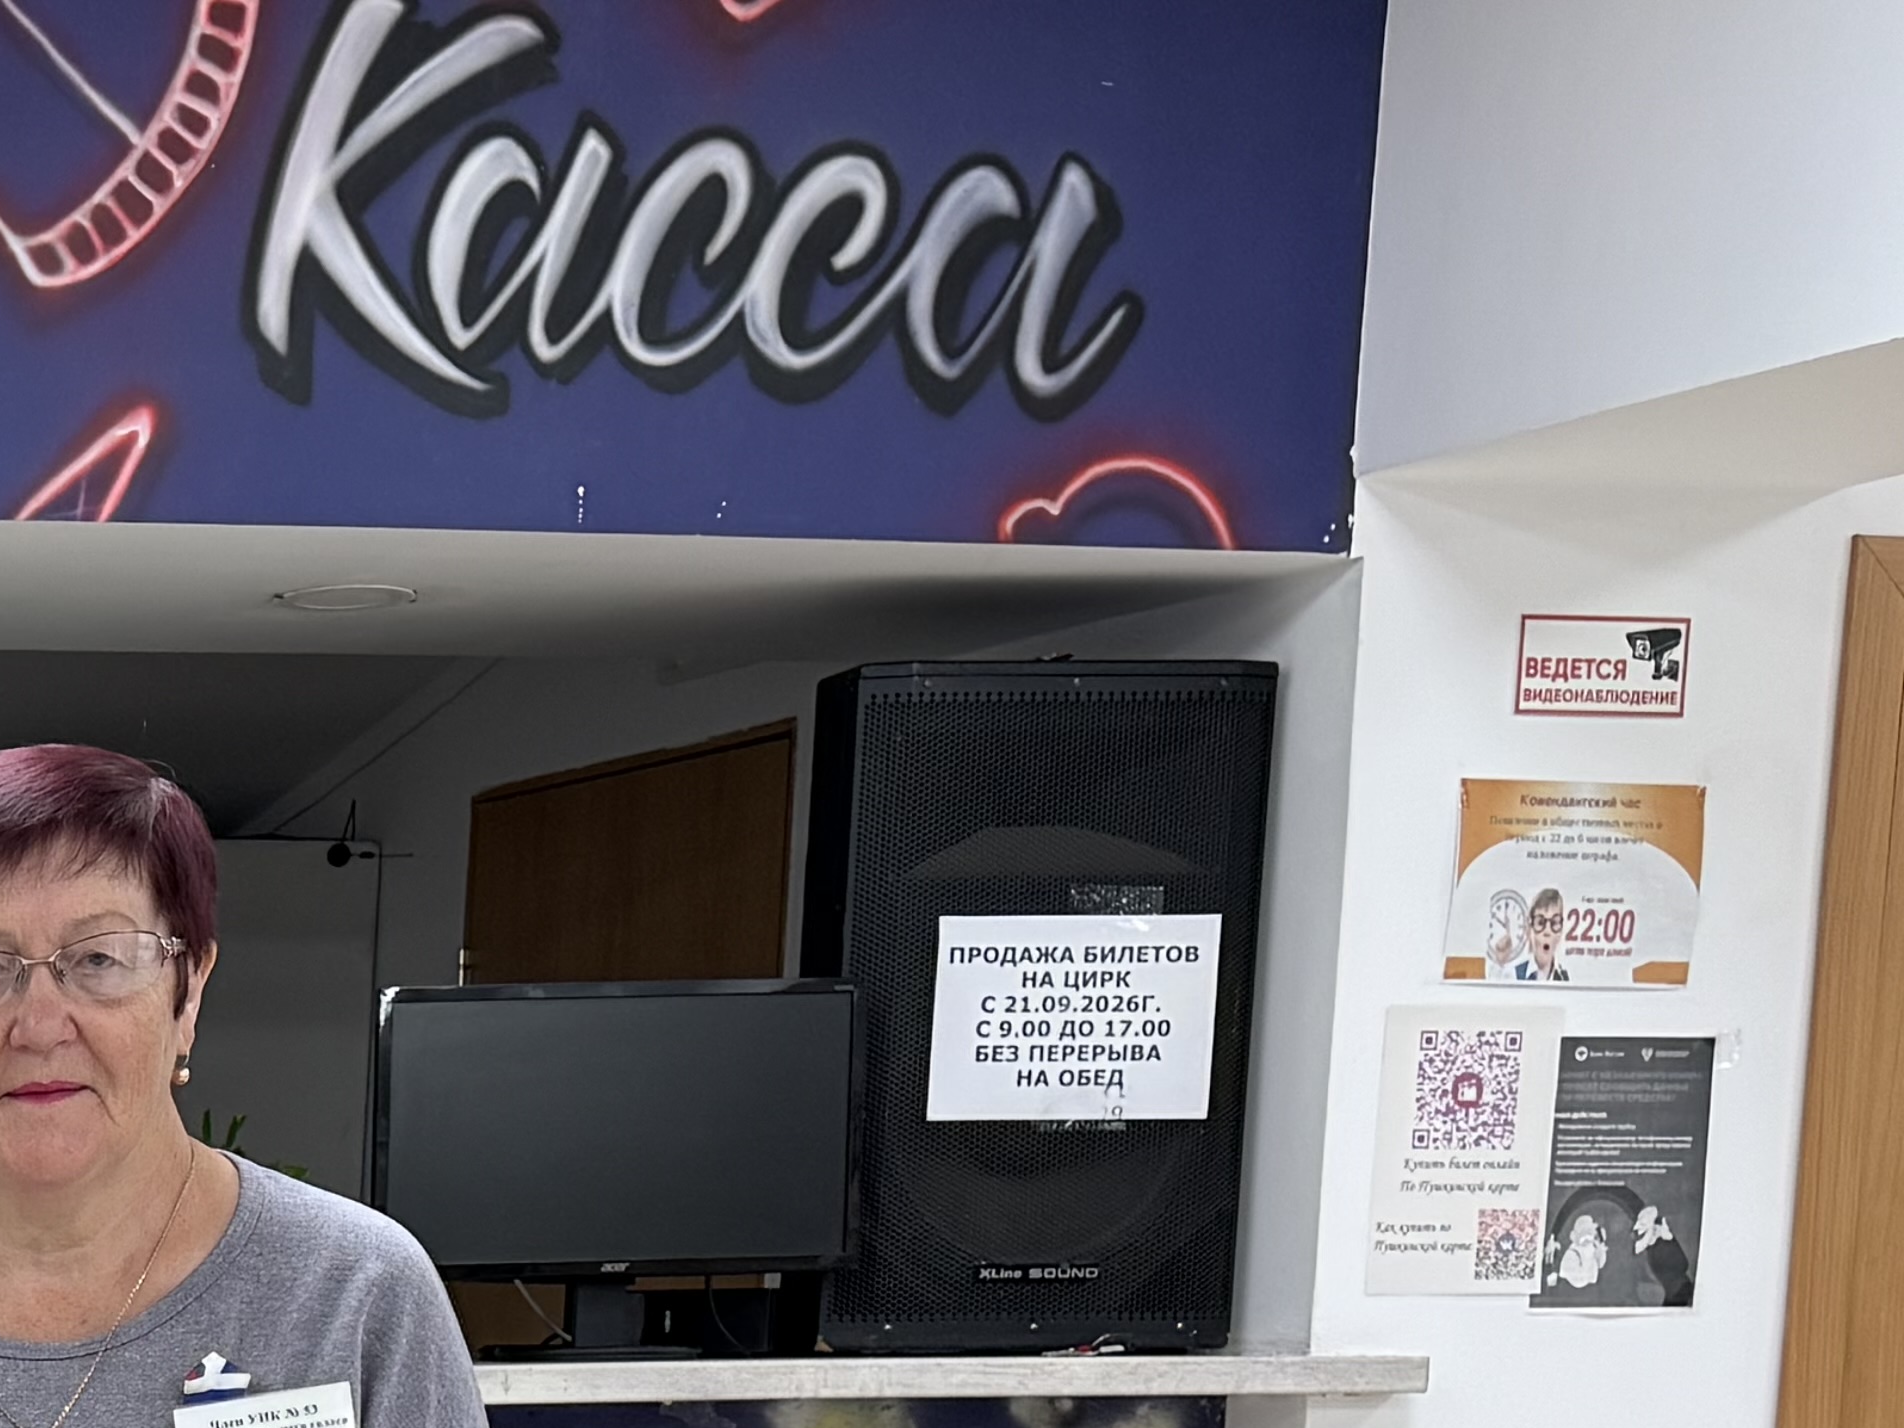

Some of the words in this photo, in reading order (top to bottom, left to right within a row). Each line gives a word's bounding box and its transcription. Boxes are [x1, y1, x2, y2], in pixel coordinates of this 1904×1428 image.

[256, 0, 1136, 395] Касса
[1525, 657, 1627, 682] ВЕДЕТСЯ
[1523, 688, 1677, 705] ВИДЕОНАБЛЮДЕНИЕ
[1565, 908, 1635, 944] 22:00
[949, 946, 1075, 968] ПРОДАЖА
[1083, 945, 1200, 964] БИЛЕТОВ
[1021, 971, 1055, 989] НА
[1063, 970, 1131, 992] ЦИРК
[980, 995, 996, 1014] С
[975, 1020, 991, 1039] С
[999, 1020, 1051, 1039] 9.00
[1058, 1019, 1095, 1042] ДО
[1105, 1019, 1171, 1037] 17.00
[975, 1044, 1019, 1063] БЕЗ
[1029, 1044, 1162, 1063] ПЕРЕРЫВА
[1016, 1069, 1049, 1088] НА
[1058, 1069, 1124, 1090] ОБЕД
[1028, 1267, 1099, 1279] SOUND
